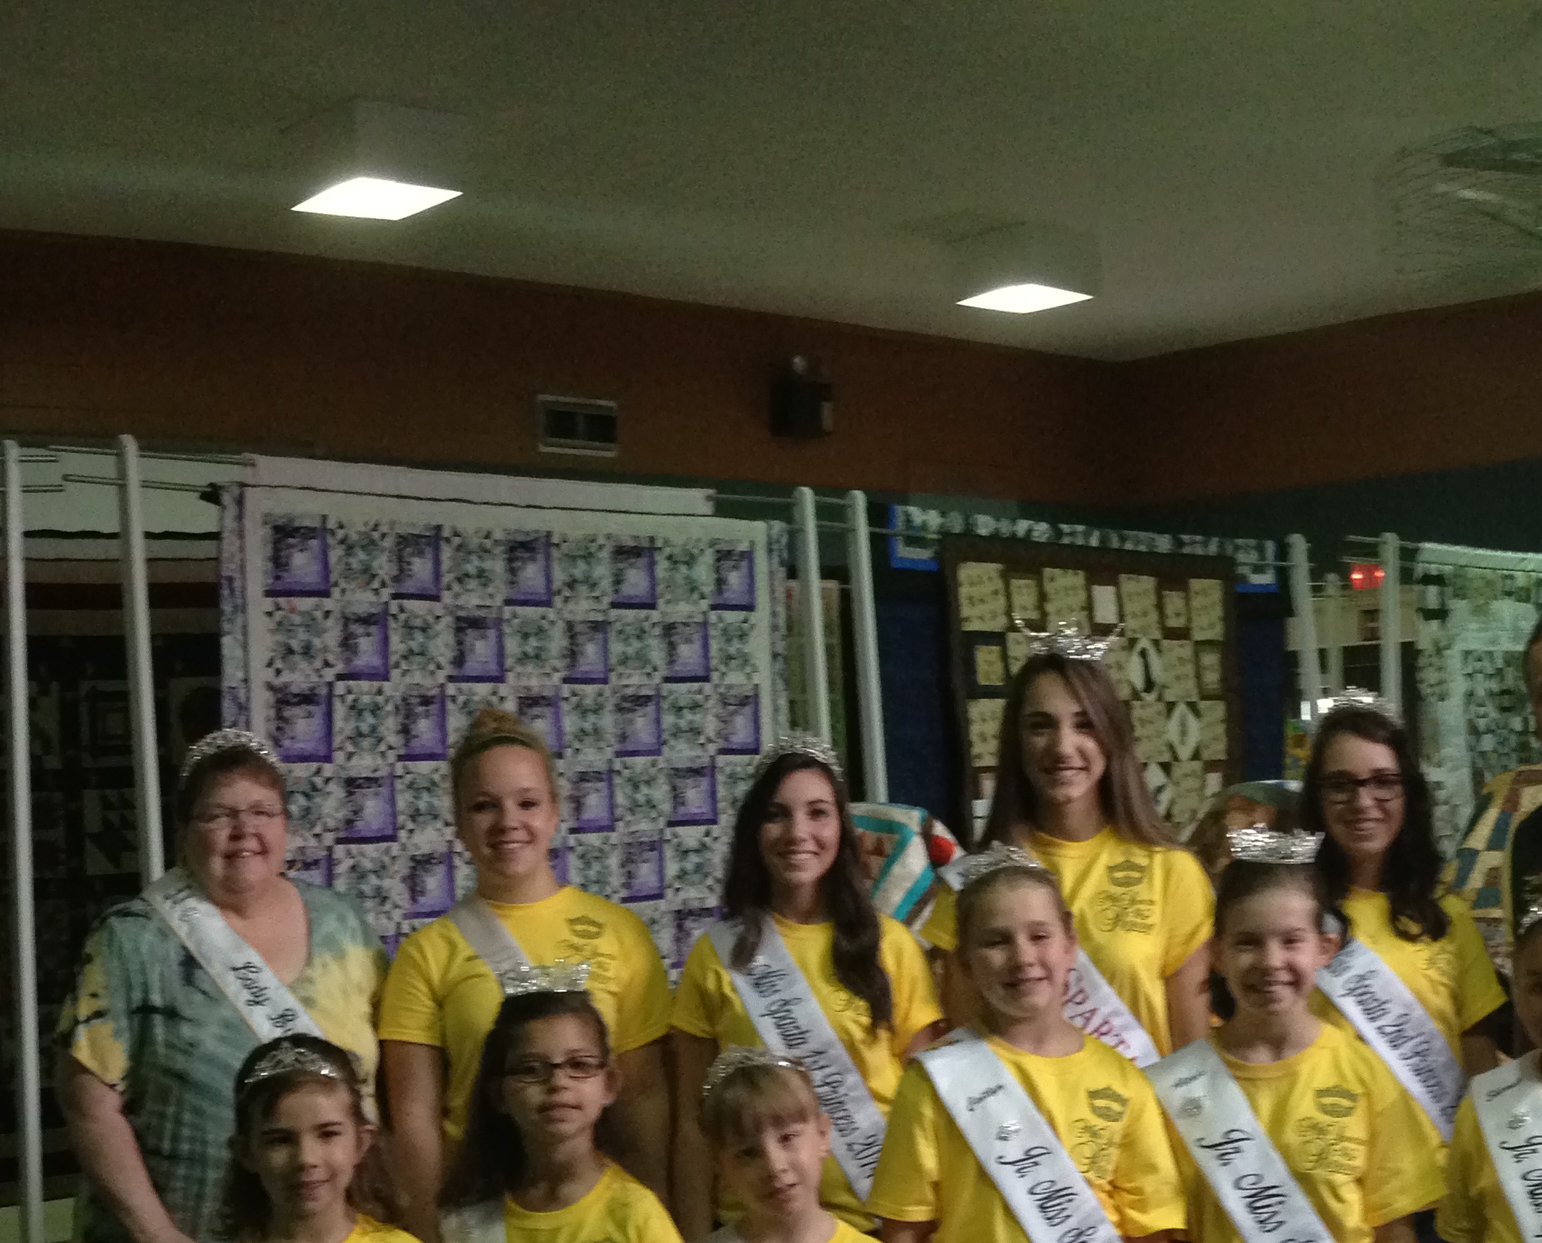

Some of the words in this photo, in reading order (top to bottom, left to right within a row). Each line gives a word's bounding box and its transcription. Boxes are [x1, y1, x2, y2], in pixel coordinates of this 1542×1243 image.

[760, 998, 813, 1050] Sparta
[815, 1072, 861, 1139] Princess
[1027, 1179, 1076, 1228] Miss
[1233, 1173, 1286, 1233] Miss
